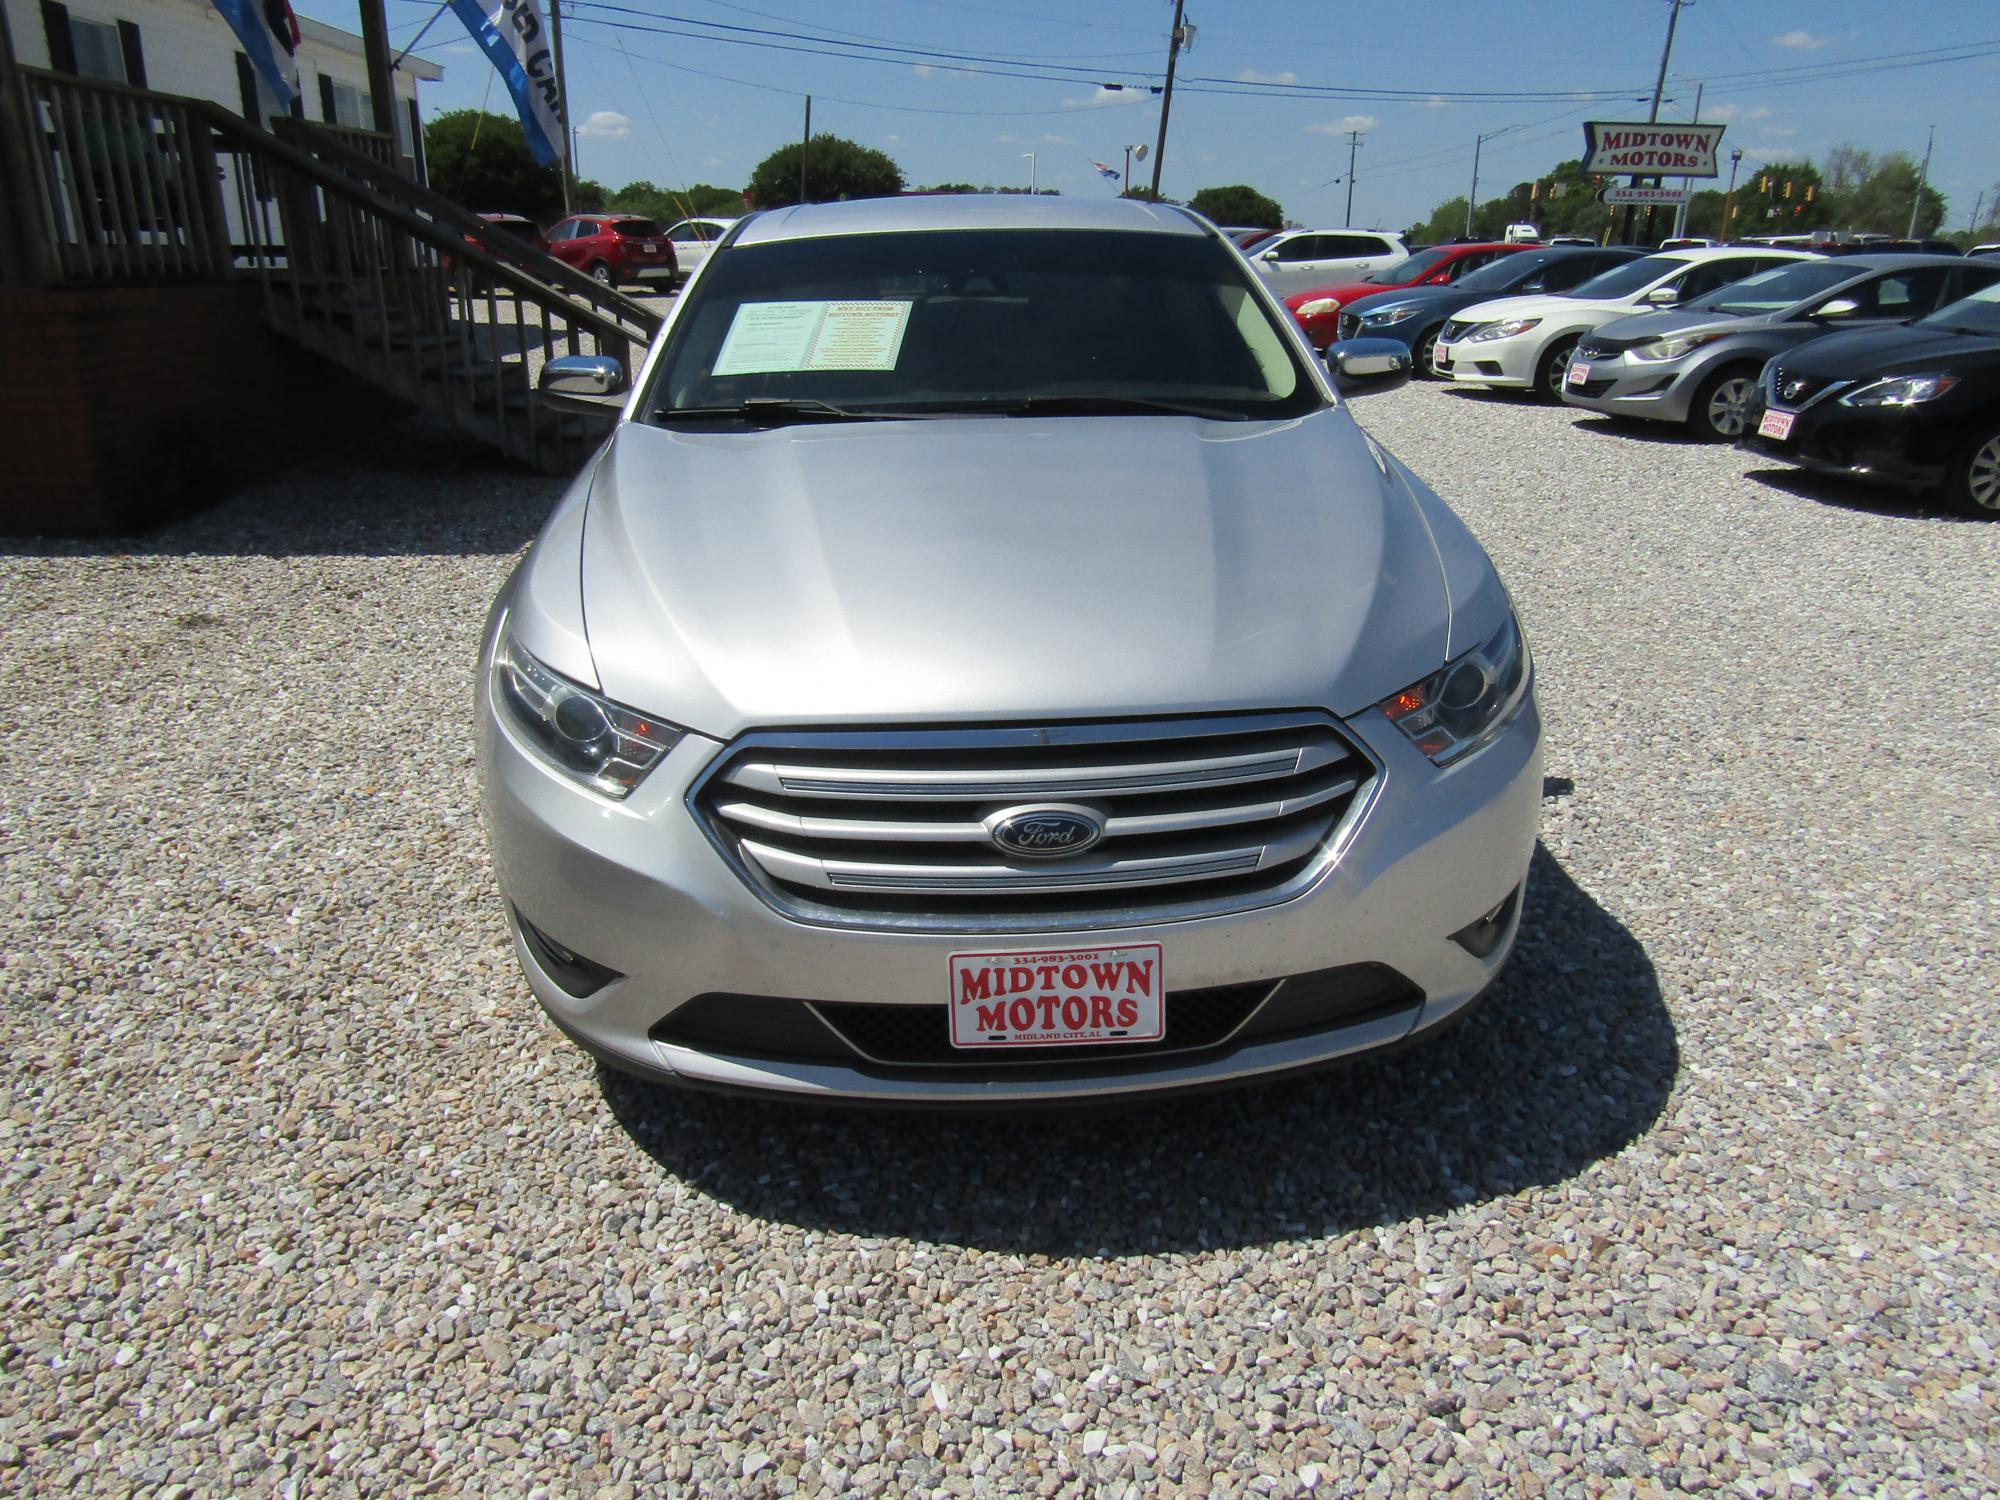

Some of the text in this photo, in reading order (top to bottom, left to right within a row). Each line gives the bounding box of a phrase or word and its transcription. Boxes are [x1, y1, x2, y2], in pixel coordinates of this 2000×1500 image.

[1601, 131, 1711, 154] MIDTOWN
[1609, 151, 1699, 168] MOTORS
[1018, 821, 1075, 846] Ford
[1013, 953, 1100, 965] 334-983-3001
[960, 959, 1154, 1006] MIDTOWN
[976, 995, 1139, 1032] MOTORS
[1014, 1031, 1061, 1041] MIDLAND
[1063, 1031, 1087, 1040] CITY,
